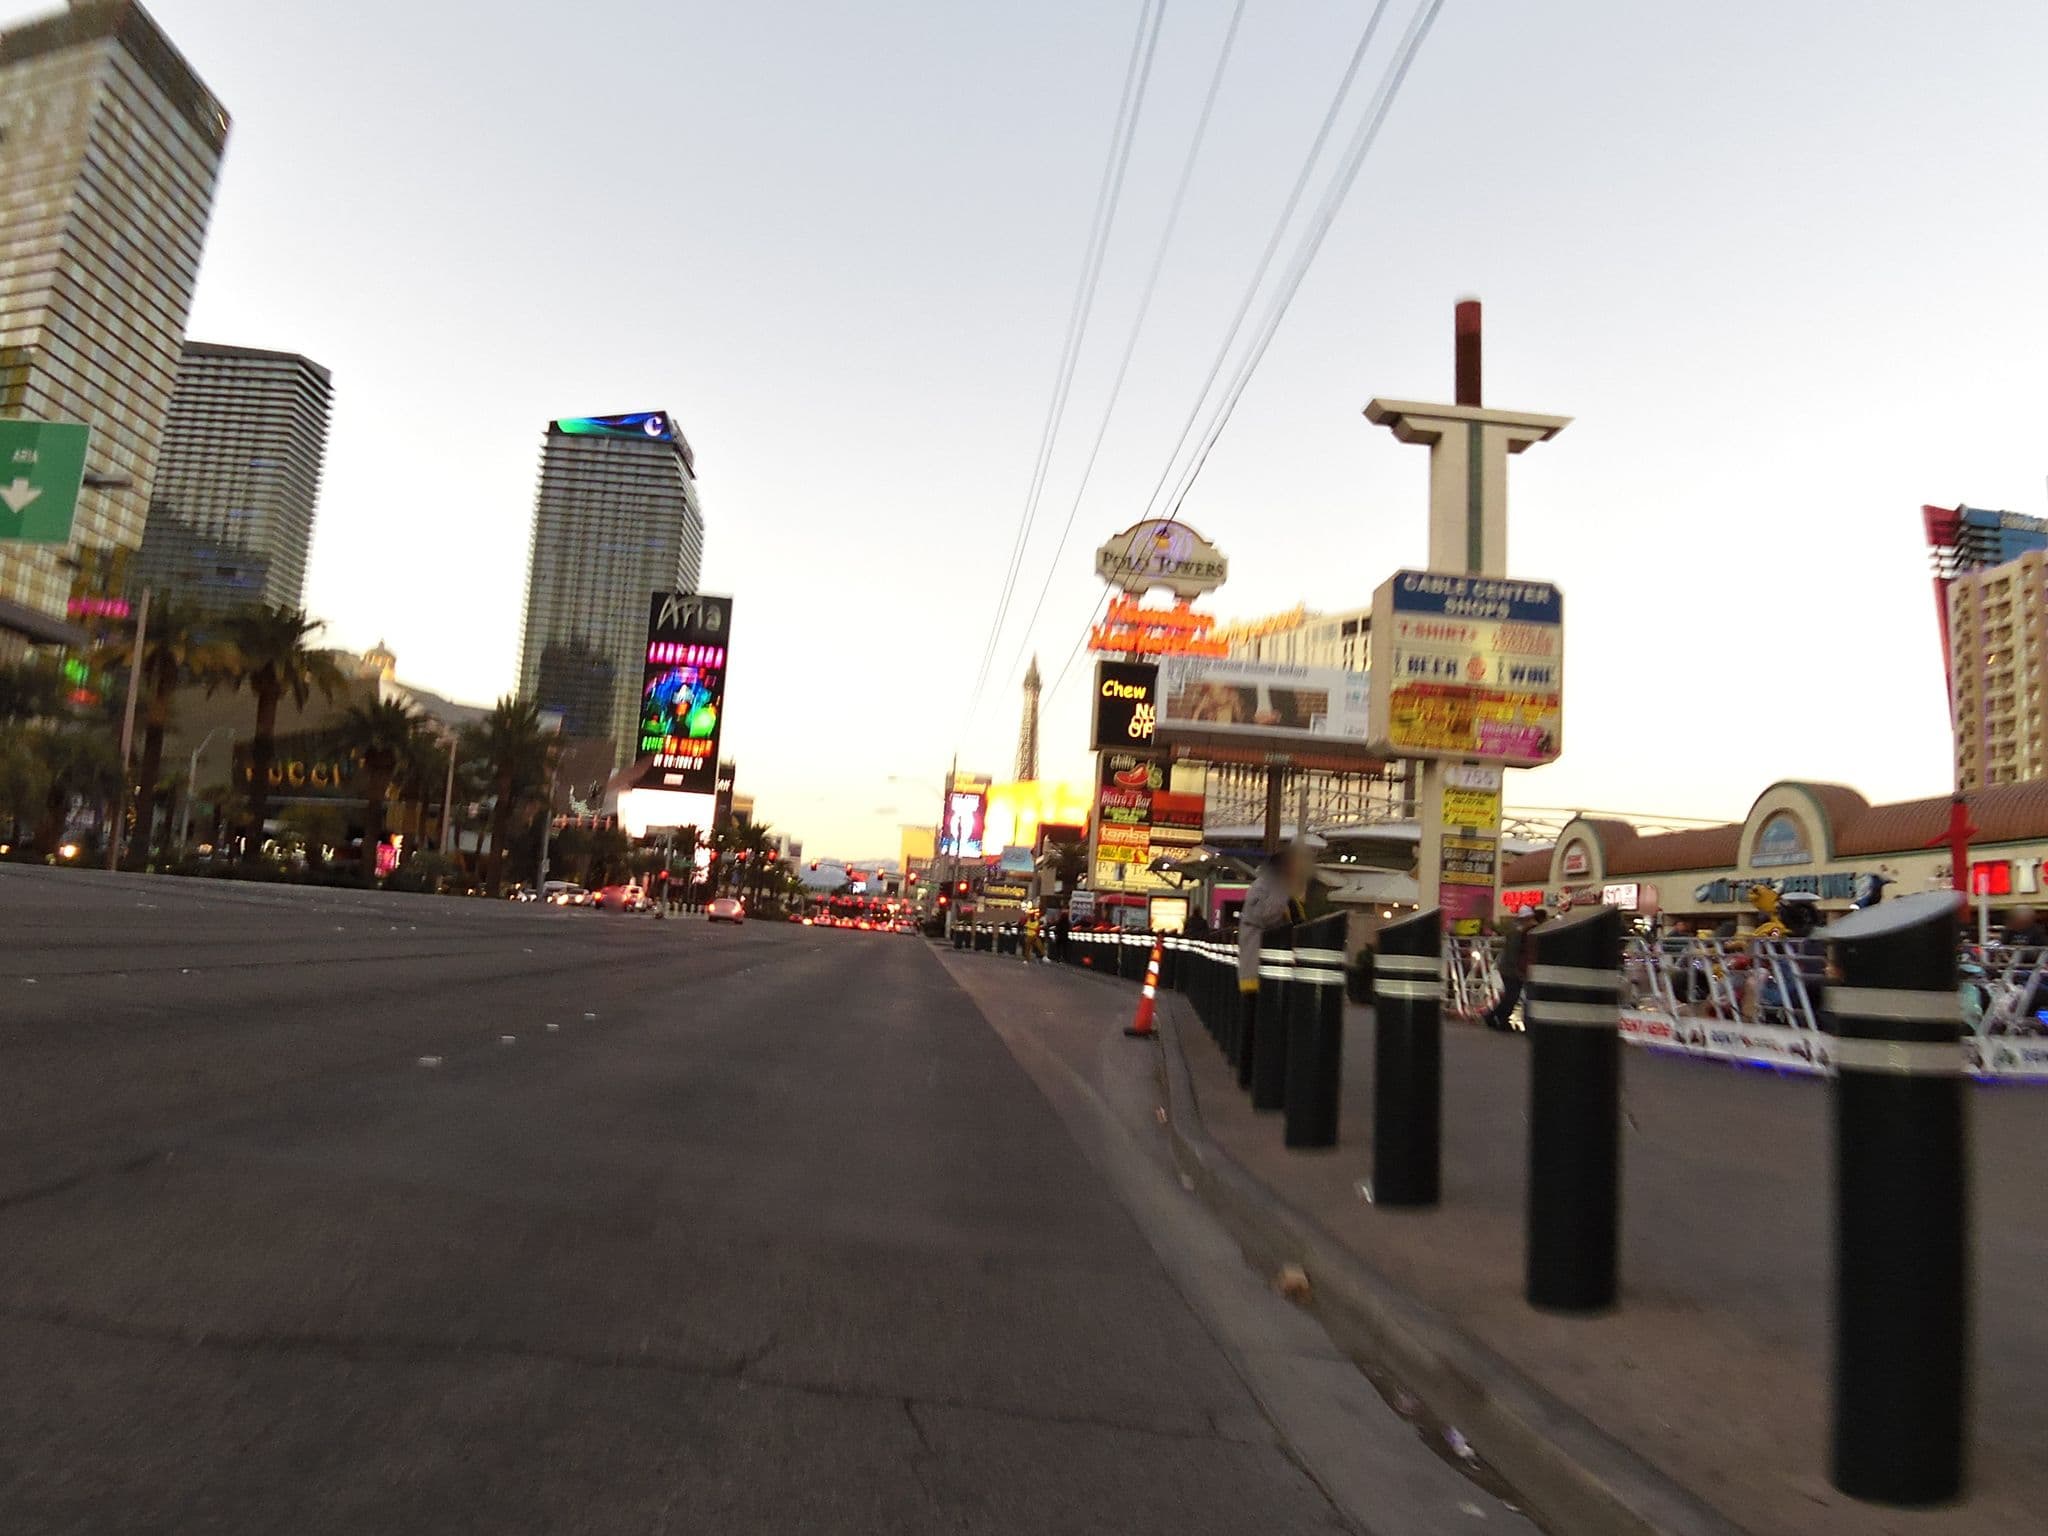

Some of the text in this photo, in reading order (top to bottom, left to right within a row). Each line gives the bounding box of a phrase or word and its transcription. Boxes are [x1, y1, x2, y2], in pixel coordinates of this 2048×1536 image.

[1102, 551, 1224, 578] POLO TOWERS
[1403, 574, 1552, 604] CABLE CENTER
[656, 593, 722, 631] Aria
[1444, 597, 1512, 619] SHOPS
[1102, 679, 1147, 699] Chew
[245, 760, 339, 789] UCCI
[1135, 793, 1152, 808] Bar
